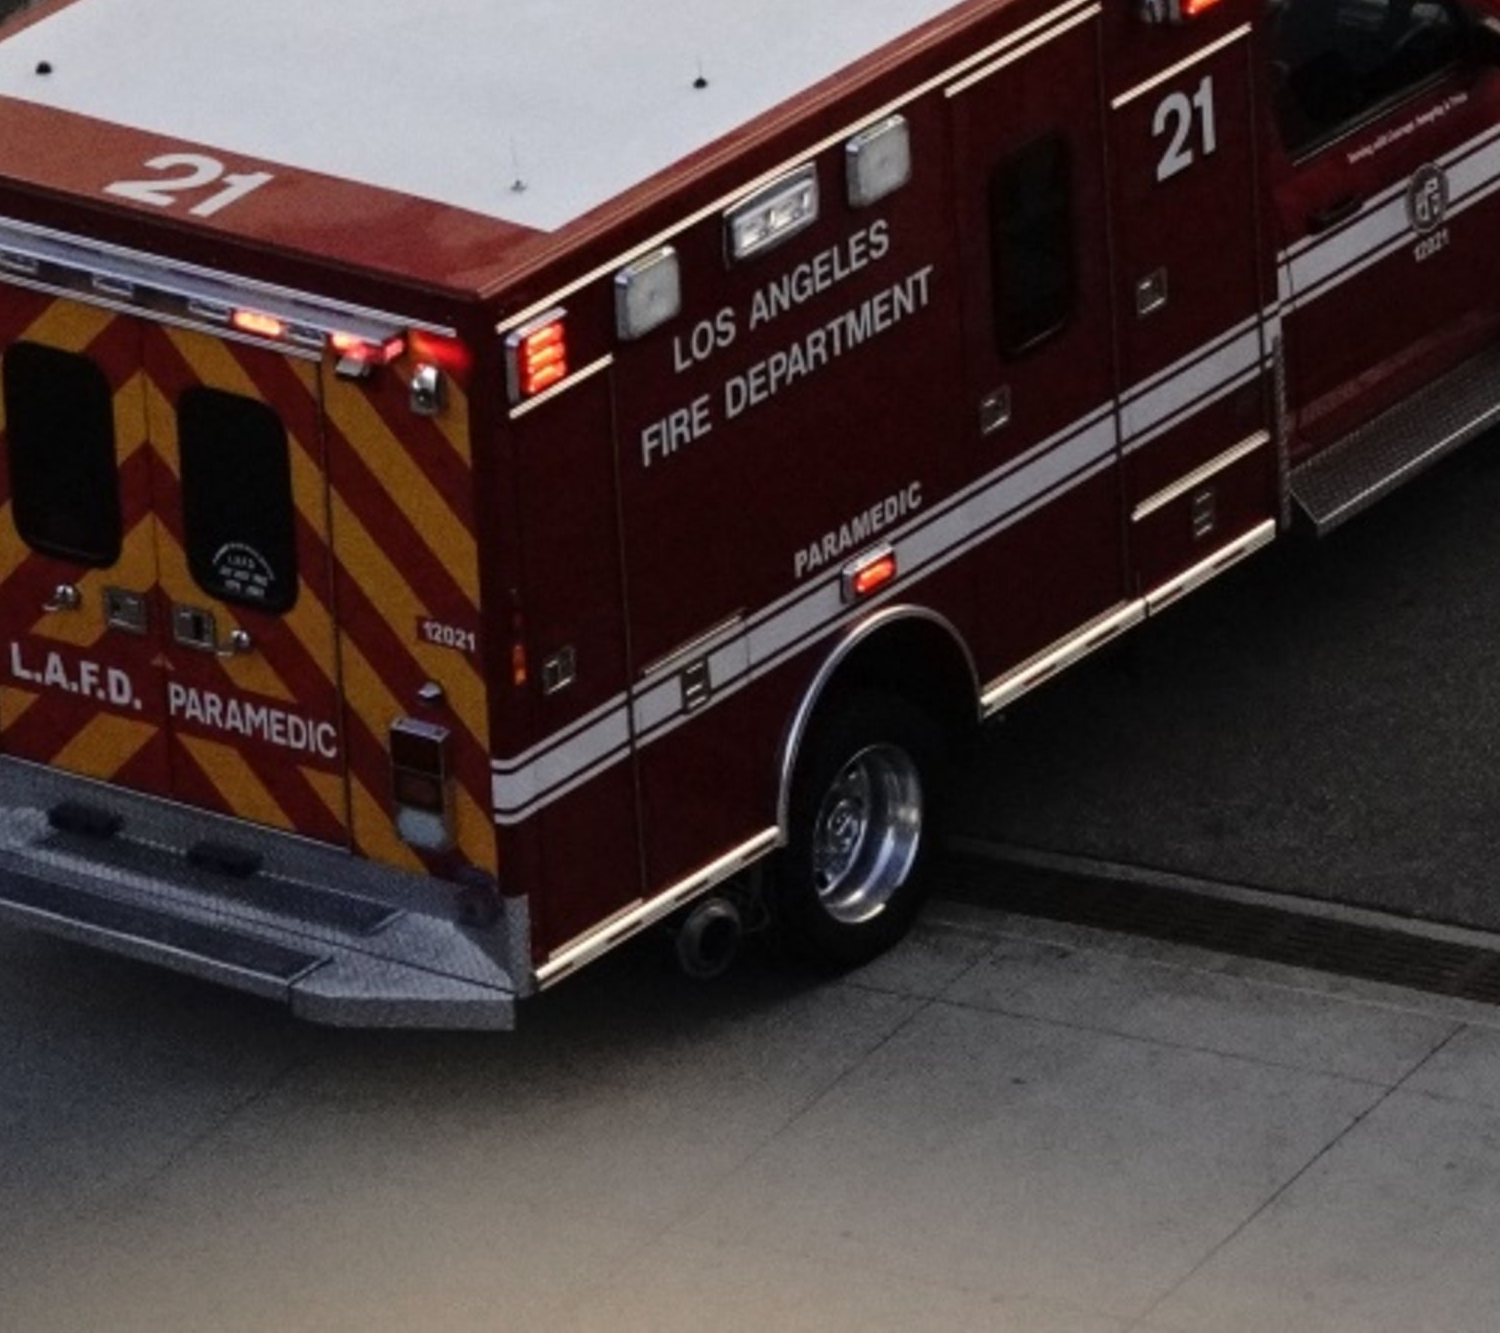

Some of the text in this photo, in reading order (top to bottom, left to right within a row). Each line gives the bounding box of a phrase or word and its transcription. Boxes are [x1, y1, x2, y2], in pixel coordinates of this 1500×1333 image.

[1152, 76, 1217, 182] 21
[104, 153, 274, 217] 21
[674, 219, 889, 373] LOS ANGELES
[641, 265, 934, 467] FIRE DEPARTMENT
[794, 481, 923, 578] PARAMEDIC
[423, 621, 475, 652] 12021
[11, 642, 337, 758] L.A.F.D. PARAMEDIC
